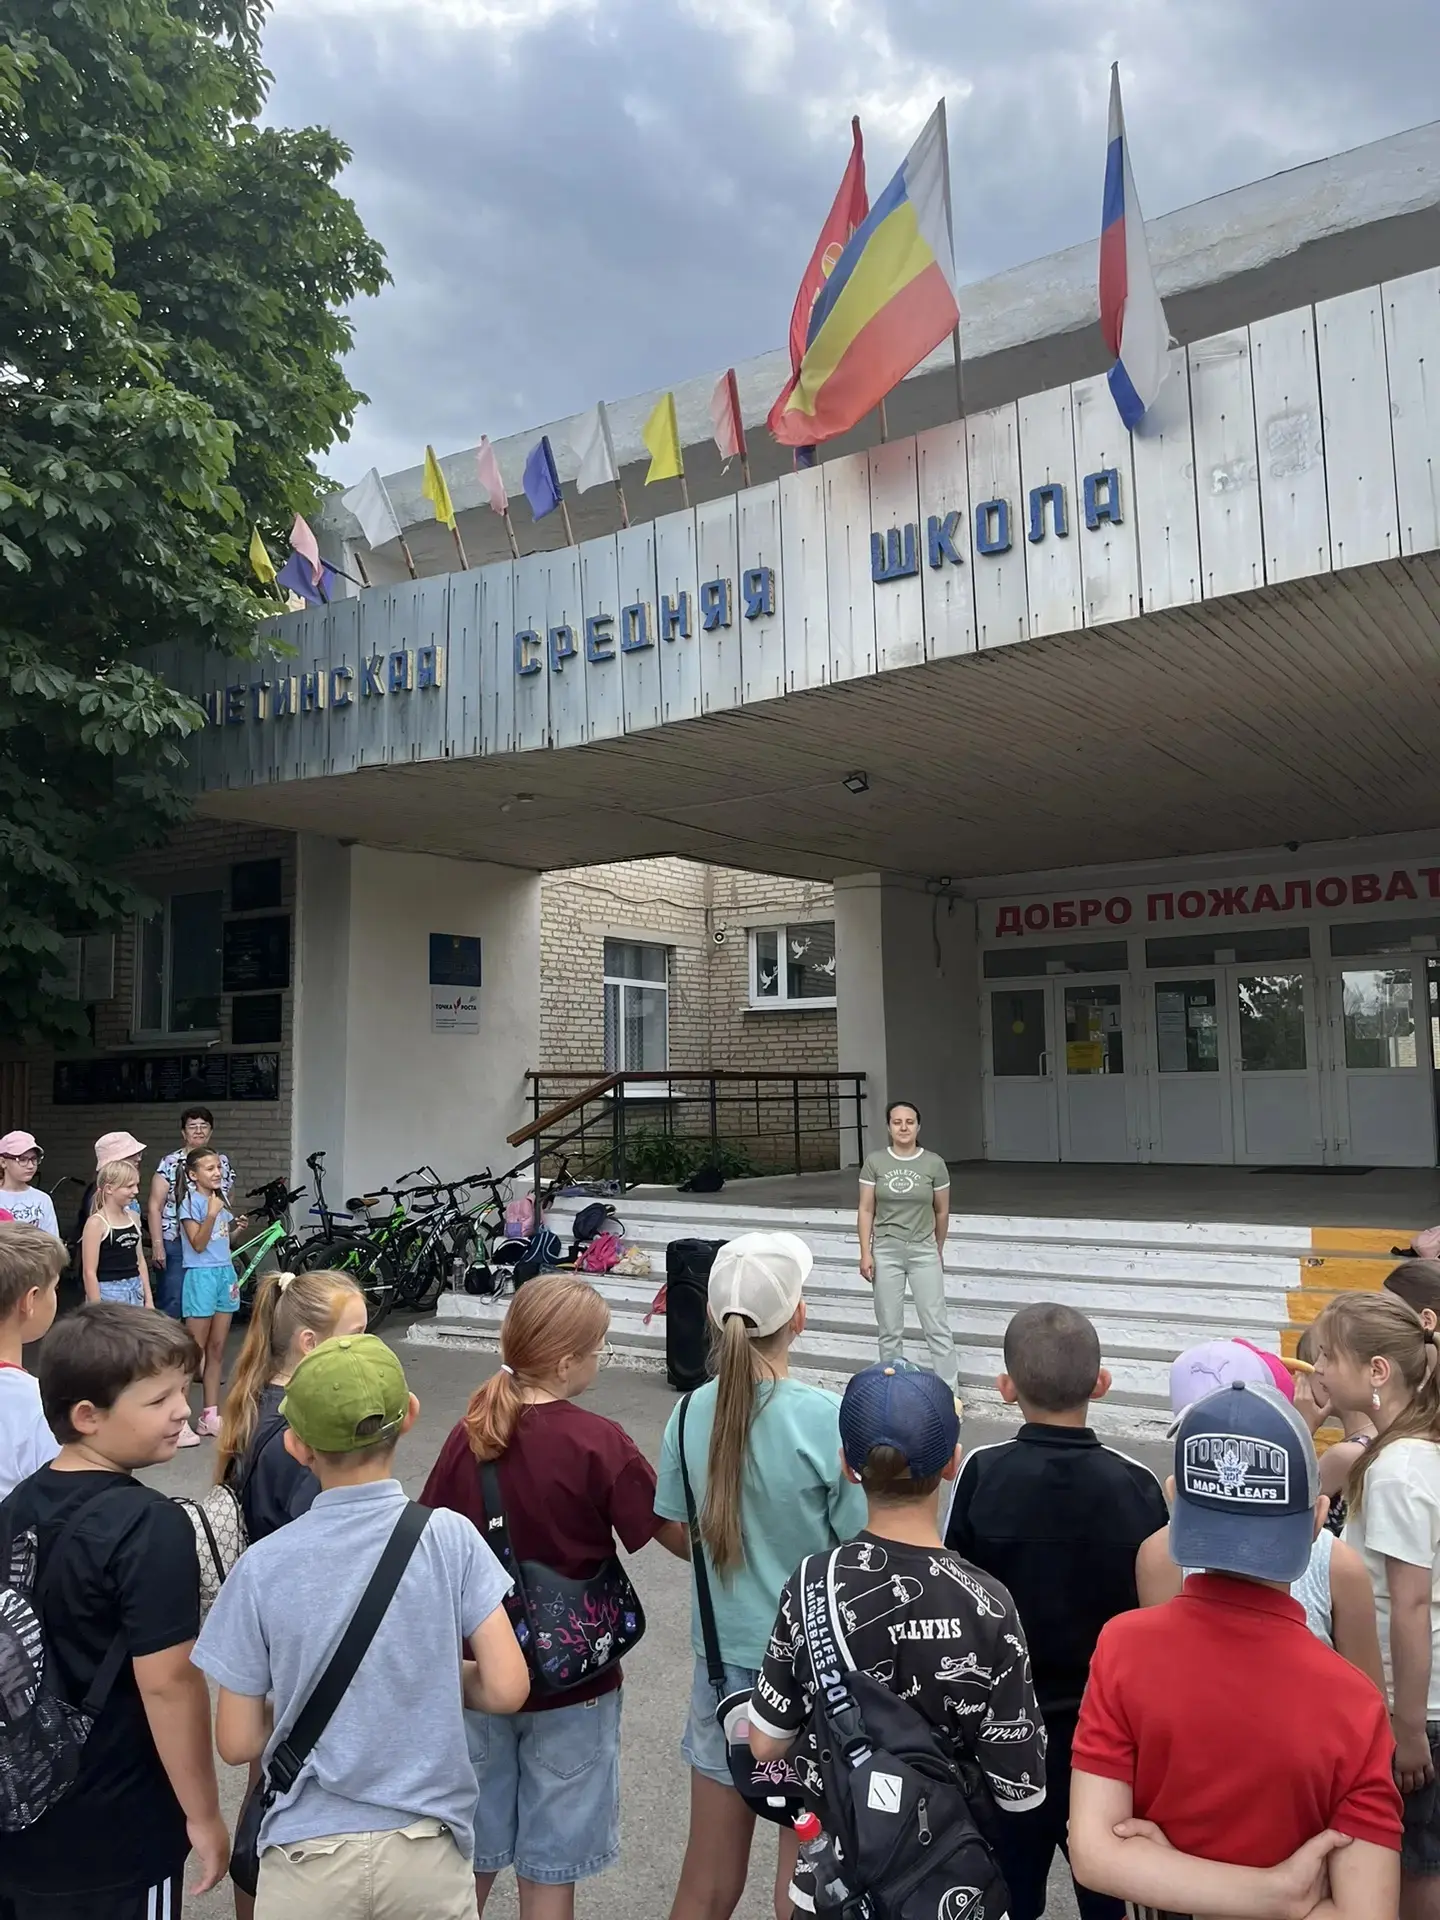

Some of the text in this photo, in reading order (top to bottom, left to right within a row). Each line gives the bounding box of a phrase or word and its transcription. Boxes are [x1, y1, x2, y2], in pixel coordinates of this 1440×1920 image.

[515, 566, 776, 675] СРЕДНЯЯ
[870, 468, 1124, 584] ШКОЛА
[995, 896, 1133, 938] ДОБРО
[1109, 1011, 1119, 1027] 1
[884, 1168, 922, 1181] ATHLETIC
[1187, 1438, 1285, 1475] TORONTO
[1193, 1479, 1278, 1500] MAPLE LEAFS
[818, 1627, 837, 1665] LIFE
